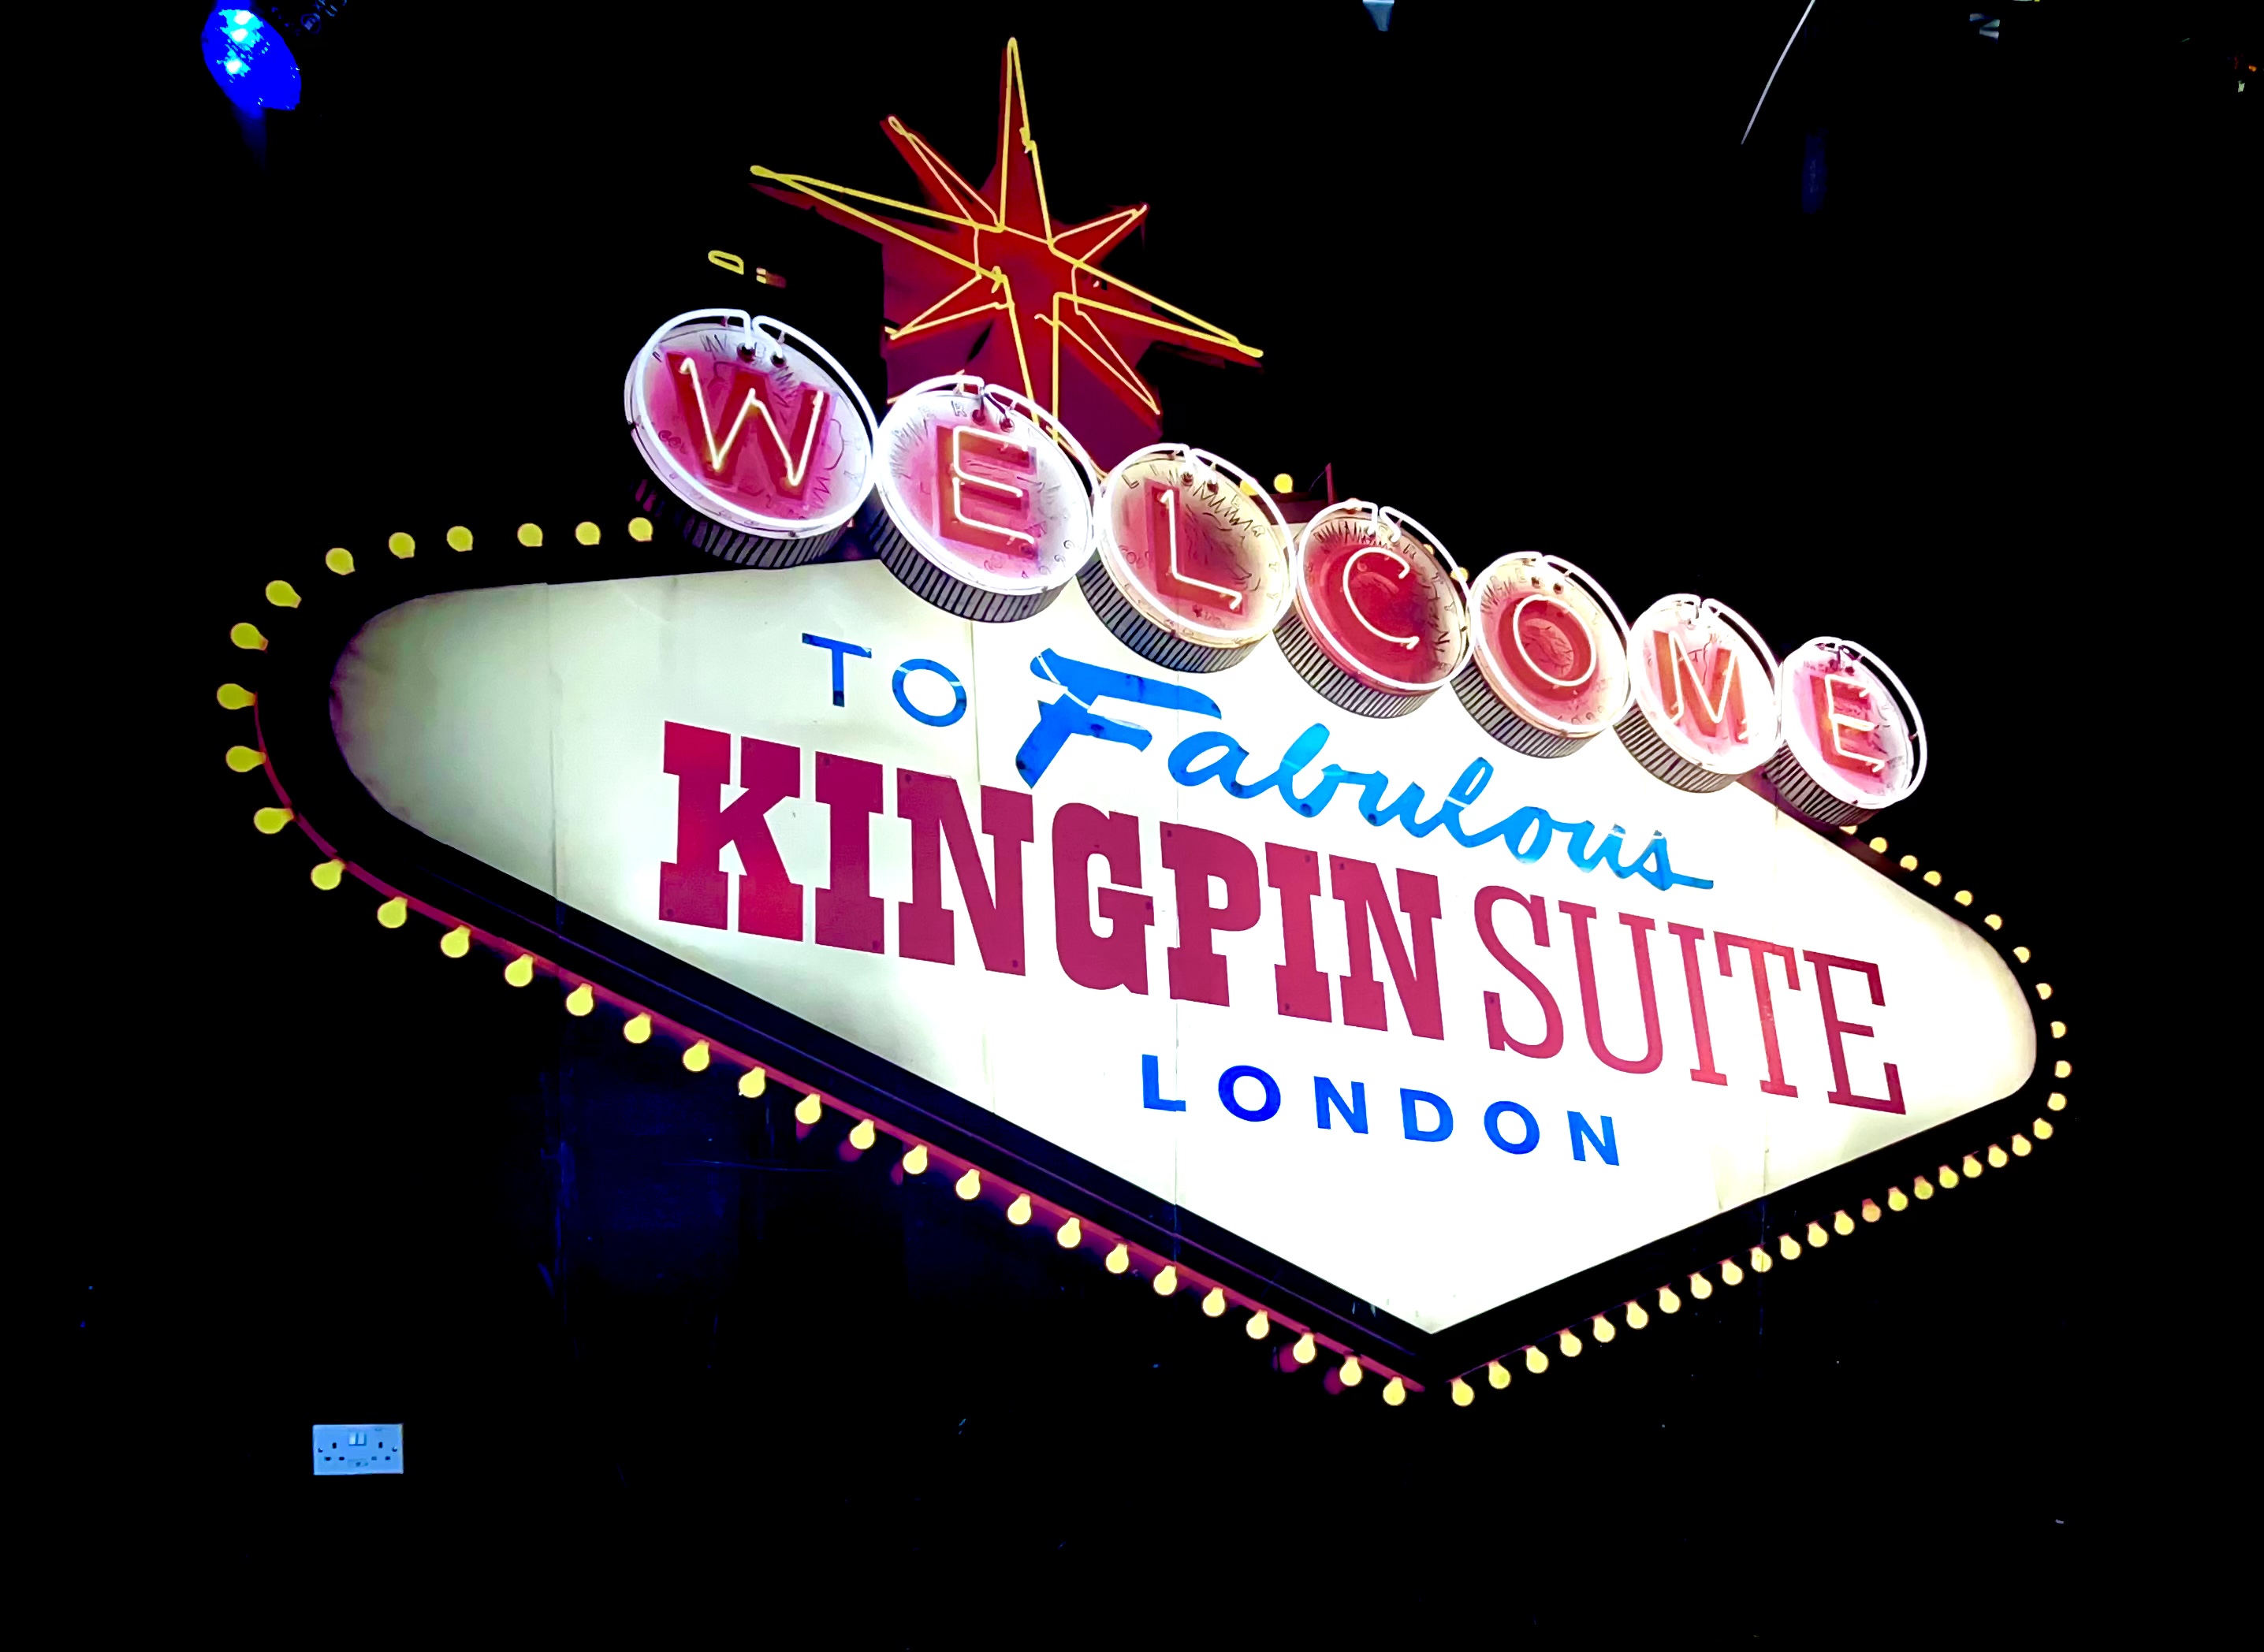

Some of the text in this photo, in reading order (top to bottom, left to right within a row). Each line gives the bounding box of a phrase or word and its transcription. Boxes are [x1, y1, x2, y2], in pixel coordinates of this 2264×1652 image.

[664, 348, 1887, 779] WELCOME
[659, 720, 1906, 1114] KINGPIN SUITE
[802, 633, 1714, 891] TO Fabulous
[1141, 1054, 1620, 1166] LONDON
